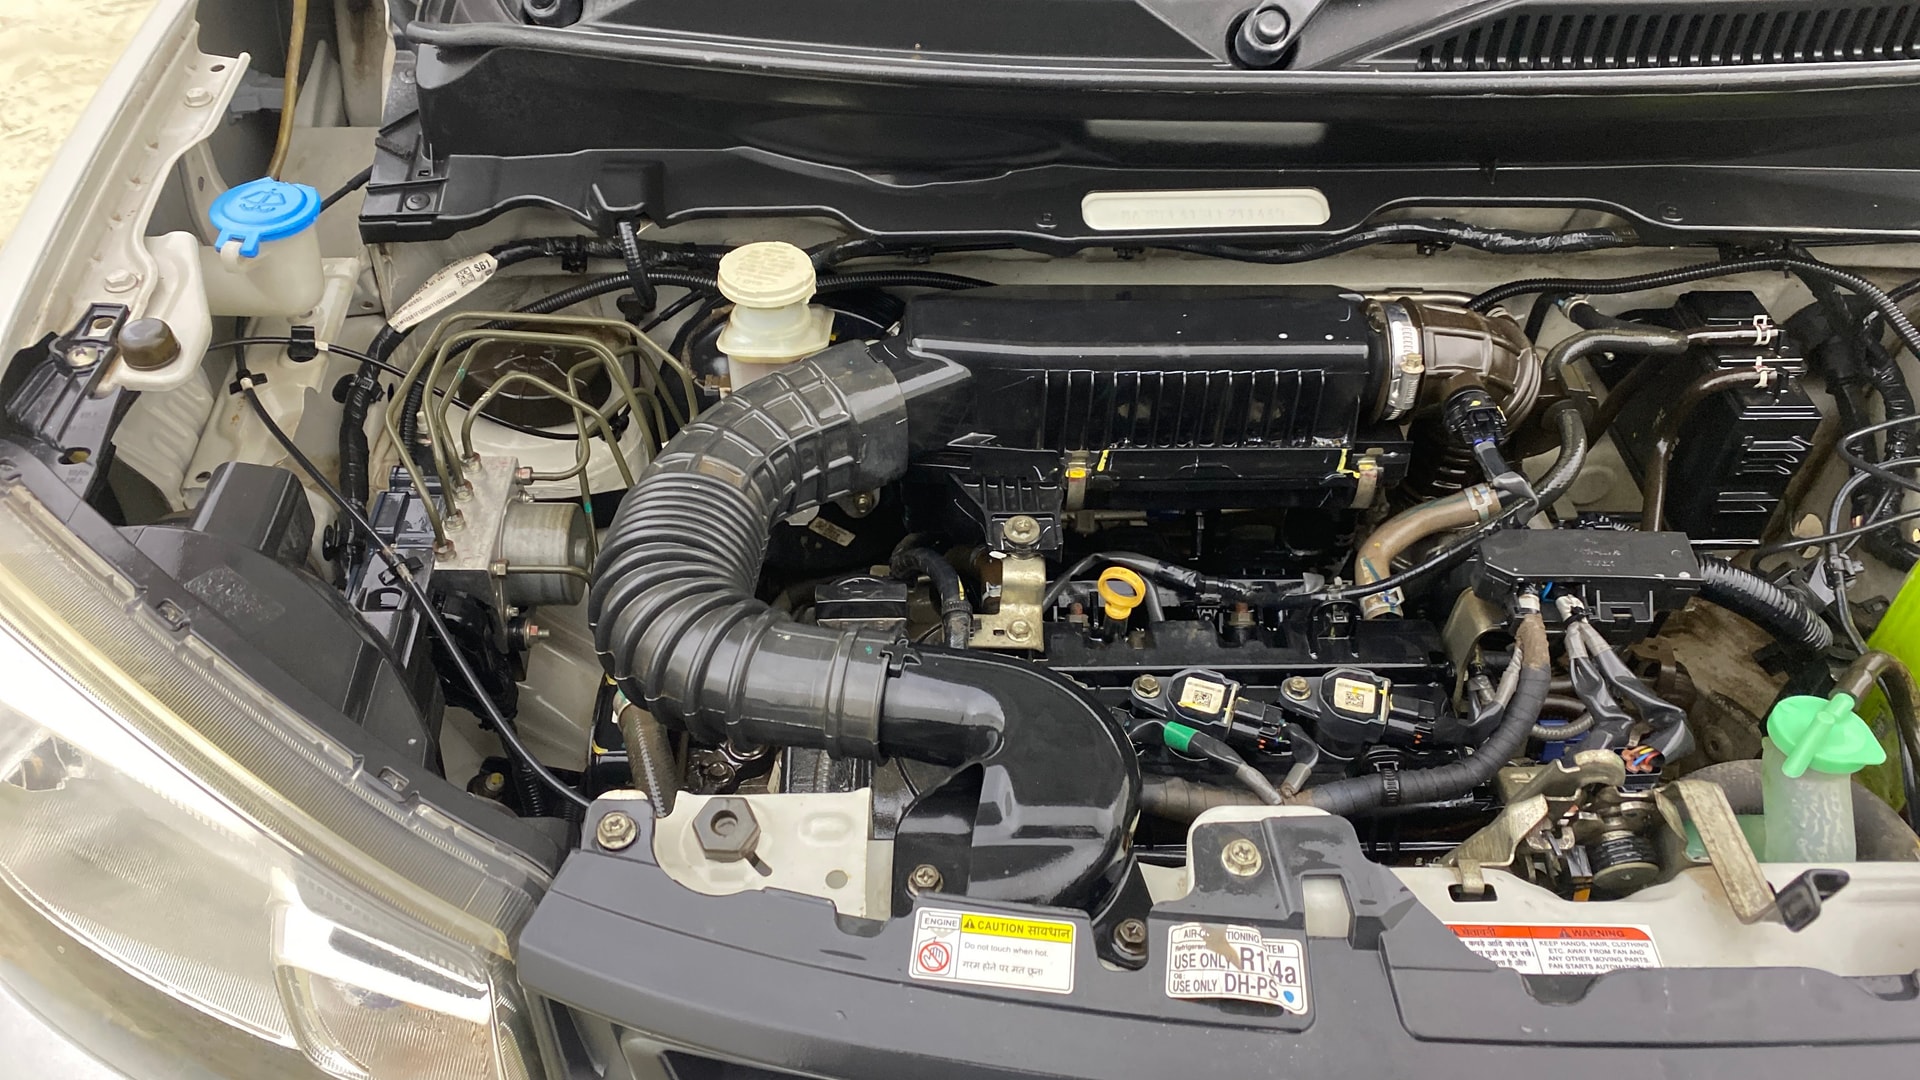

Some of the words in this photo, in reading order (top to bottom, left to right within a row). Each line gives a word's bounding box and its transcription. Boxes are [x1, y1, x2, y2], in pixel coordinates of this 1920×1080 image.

[924, 917, 958, 927] ENGINE
[977, 920, 1024, 934] CAUTION
[1028, 925, 1070, 939] सावधान
[1572, 929, 1626, 938] WARNING
[964, 941, 975, 950] Do
[977, 943, 989, 951] not
[990, 945, 1011, 953] touch
[1013, 947, 1033, 955] when
[1035, 949, 1049, 957] hot.
[1175, 943, 1208, 952] Refrigeran
[1174, 953, 1196, 969] USE
[1200, 953, 1231, 969] ONLY
[1173, 980, 1191, 992] USE
[1193, 980, 1218, 992] ONLY
[1225, 973, 1279, 998] DH-PS
